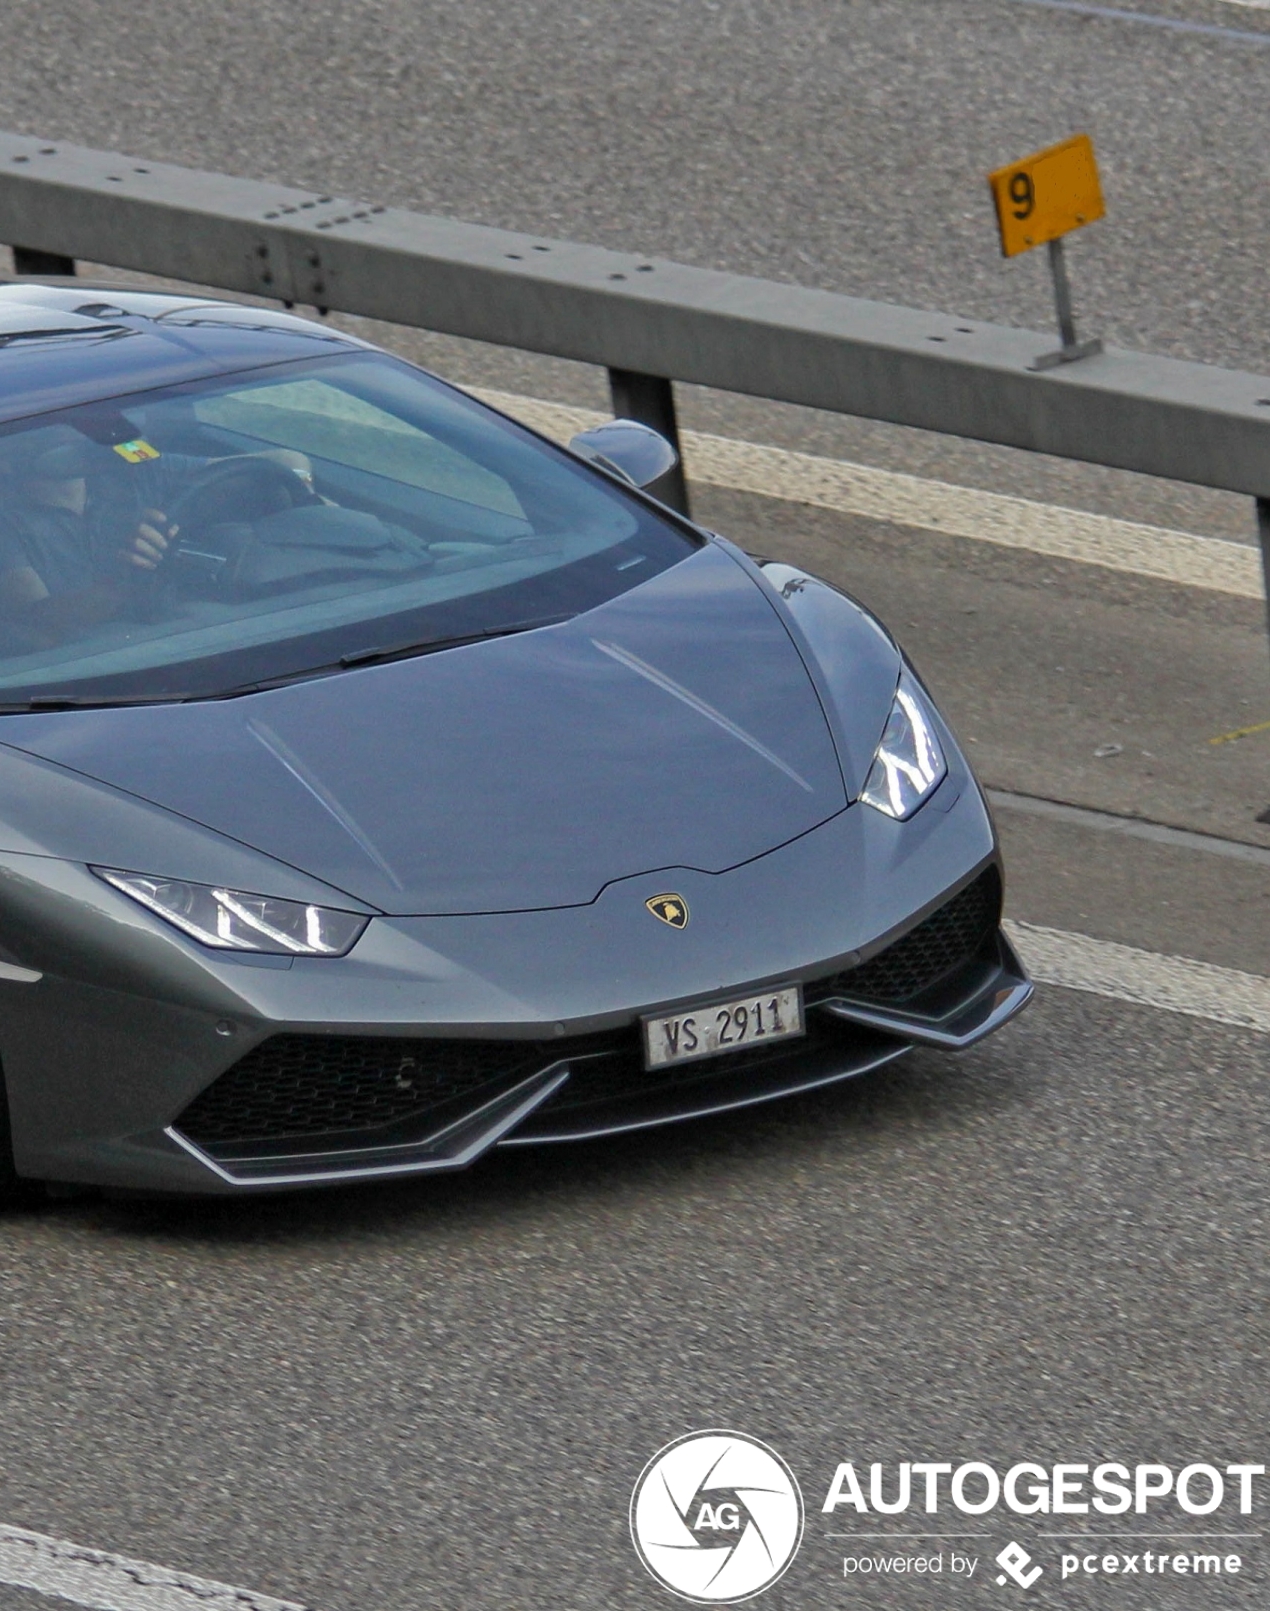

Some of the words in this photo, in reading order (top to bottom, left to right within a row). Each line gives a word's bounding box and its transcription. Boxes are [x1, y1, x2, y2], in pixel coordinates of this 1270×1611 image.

[1010, 172, 1035, 220] 9
[664, 1017, 699, 1054] VS
[716, 997, 782, 1043] 2911
